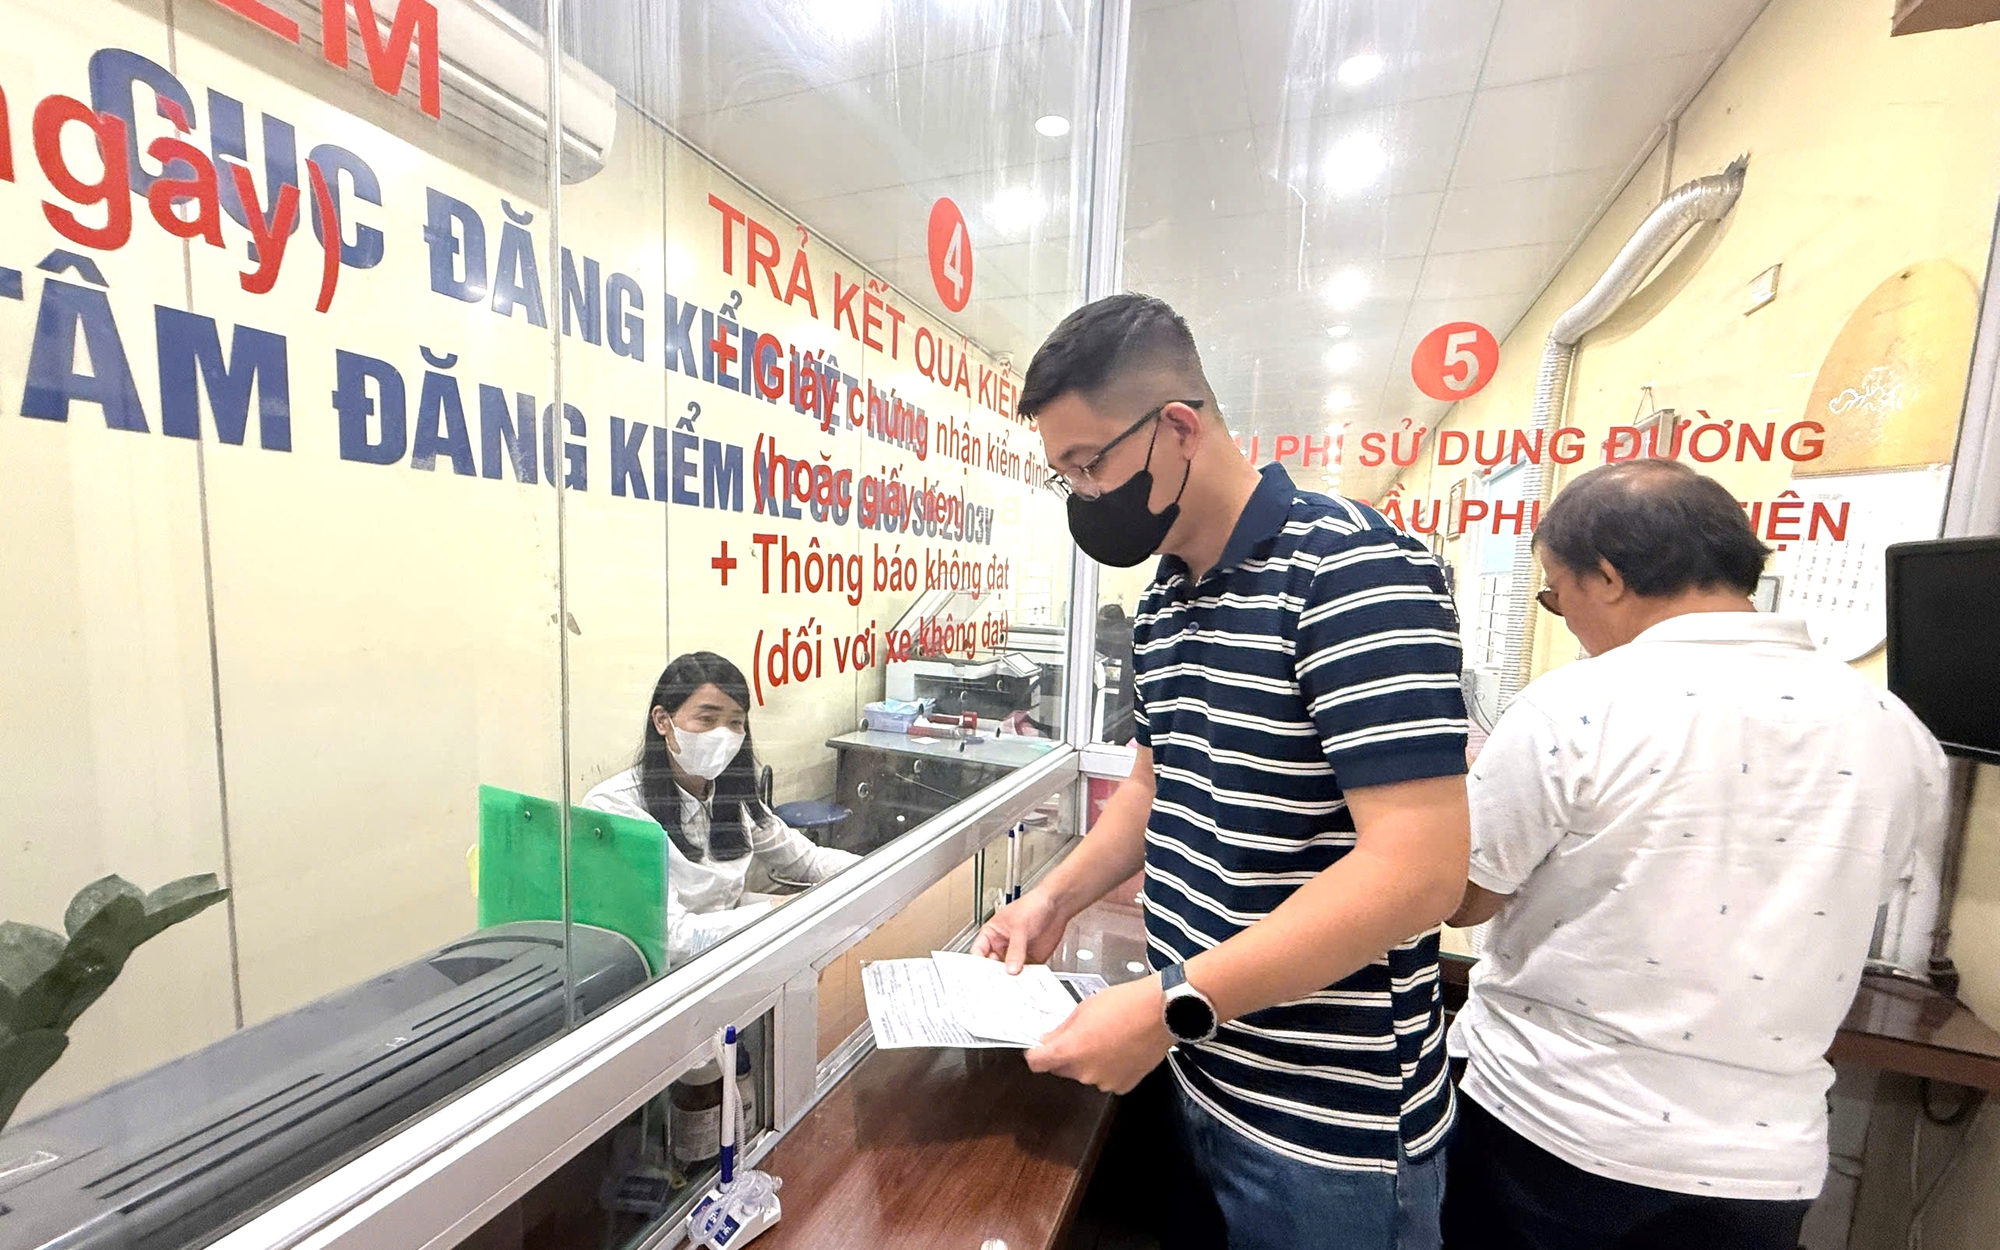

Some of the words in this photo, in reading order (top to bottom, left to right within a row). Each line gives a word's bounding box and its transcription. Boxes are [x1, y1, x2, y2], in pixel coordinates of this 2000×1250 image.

[213, 0, 441, 119] M
[423, 186, 646, 362] ĐĂNG
[664, 289, 777, 404] KIỂM
[708, 193, 819, 320] TRẢ
[834, 272, 905, 360] KẾT
[914, 326, 971, 399] QUẢ
[943, 221, 964, 302] 4
[754, 333, 839, 432] Giấy
[849, 378, 929, 461] chứng
[936, 416, 982, 475] nhận
[986, 429, 1020, 481] kiểm
[1442, 331, 1480, 391] 5
[332, 345, 588, 490] ĐĂNG
[610, 401, 744, 513] KIỂM
[1274, 422, 1350, 467] PHÍ
[1359, 417, 1427, 467] SỬ
[1437, 428, 1585, 475] DỤNG
[1603, 410, 1826, 465] ĐƯỜNG
[753, 433, 853, 522] (hoặc
[862, 463, 915, 532] giấy
[1356, 483, 1440, 534] ẦU
[1740, 490, 1851, 551] IỆN
[752, 533, 863, 606] Thông
[873, 543, 917, 592] báo
[925, 548, 982, 600] không
[987, 553, 1010, 601] đạt
[753, 617, 822, 706] (đối
[885, 629, 911, 664] xe
[919, 613, 977, 660] không
